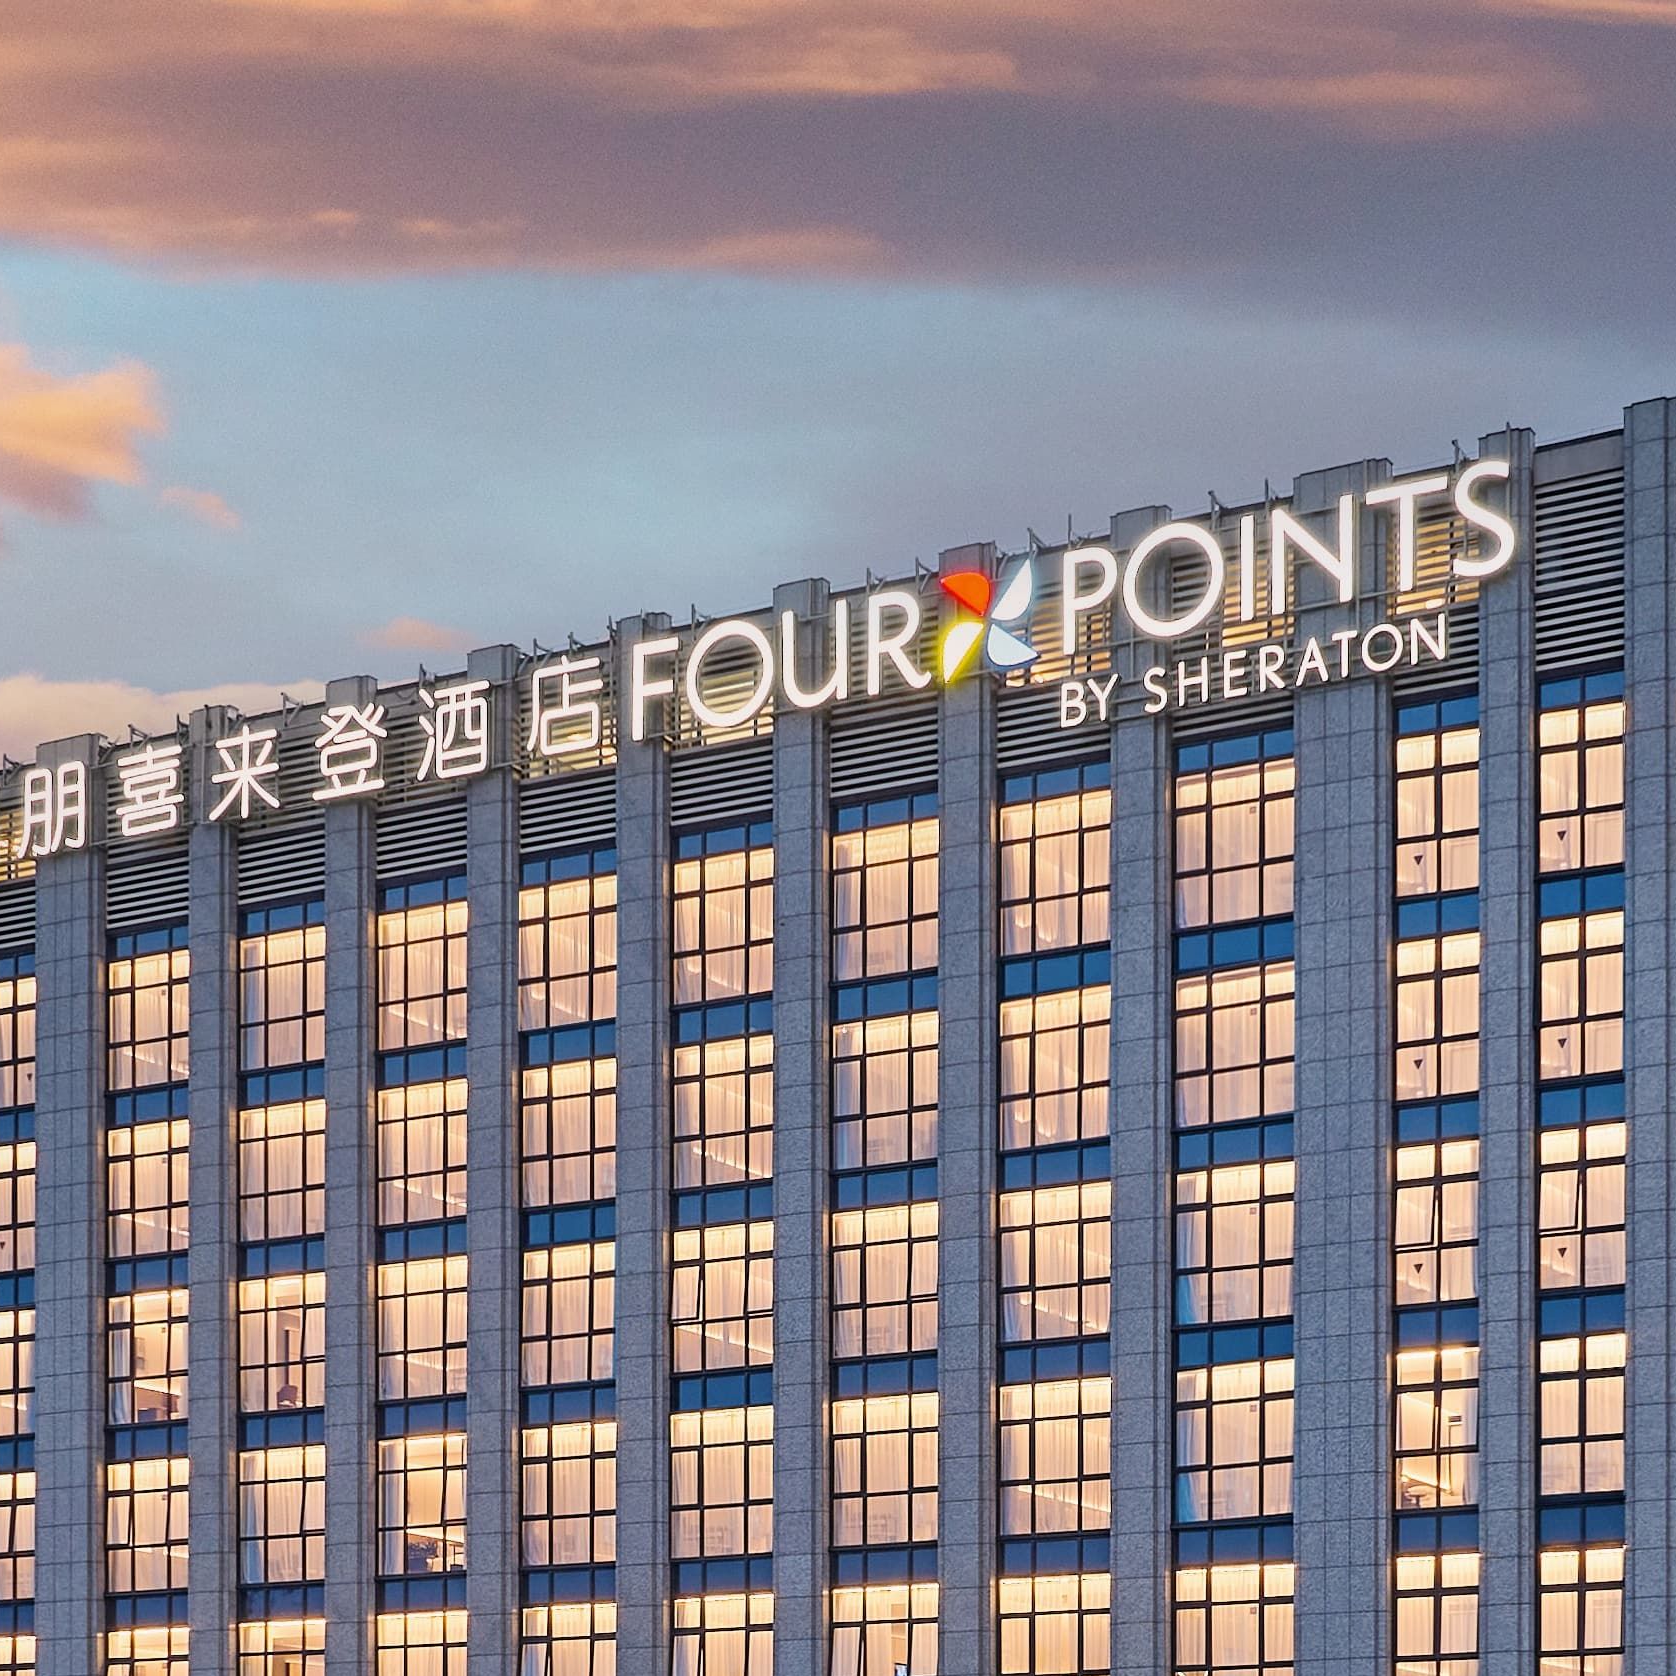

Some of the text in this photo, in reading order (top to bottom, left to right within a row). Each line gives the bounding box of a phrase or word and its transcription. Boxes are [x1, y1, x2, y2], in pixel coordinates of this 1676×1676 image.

[631, 590, 931, 742] FOUR
[1061, 460, 1516, 656] POINTS
[1059, 612, 1447, 729] BY SHERATON
